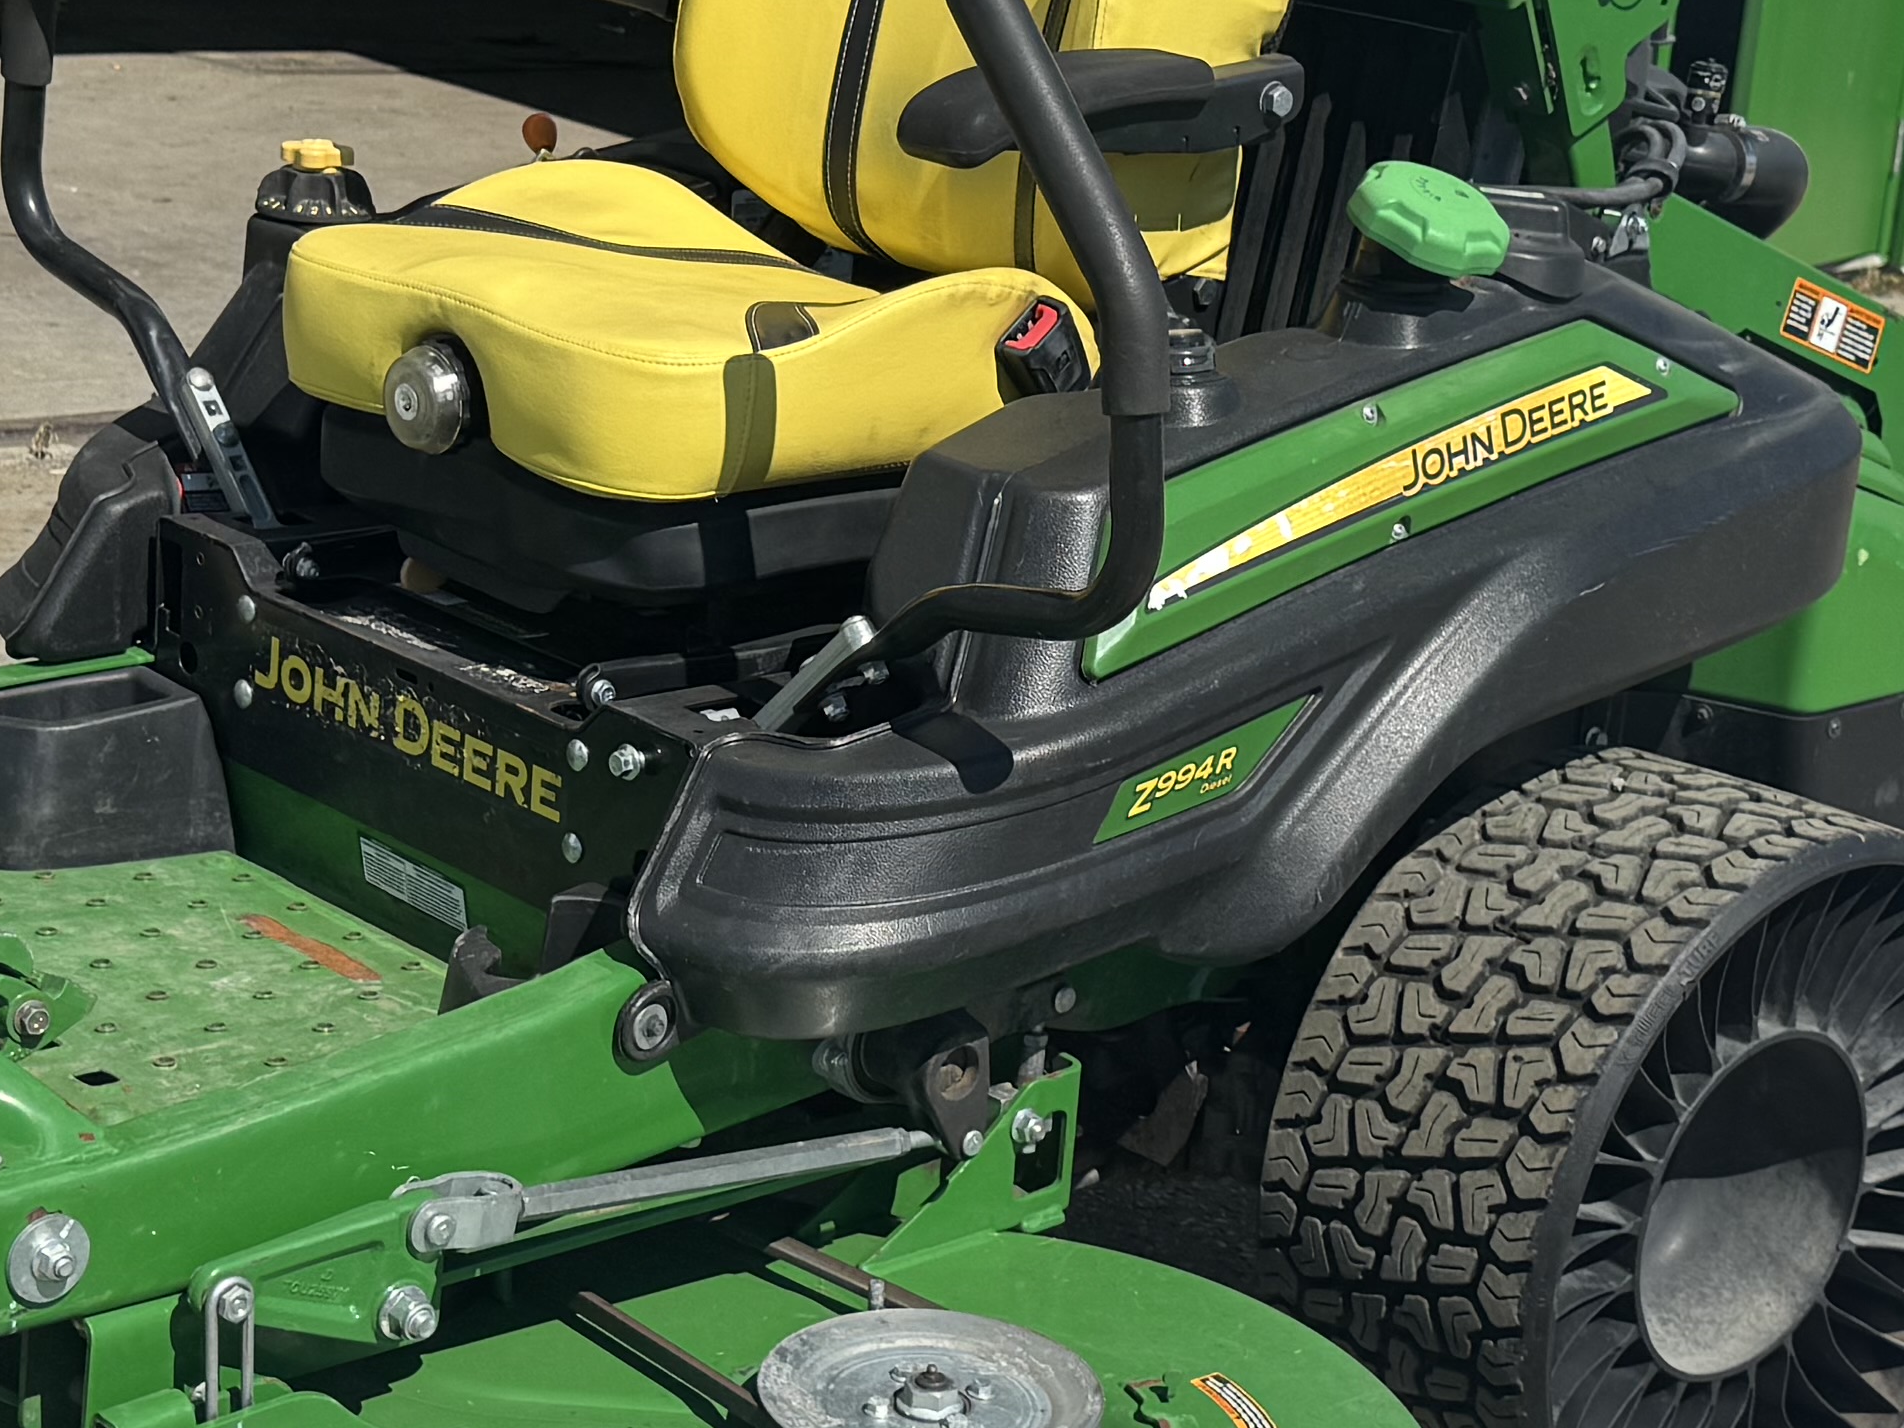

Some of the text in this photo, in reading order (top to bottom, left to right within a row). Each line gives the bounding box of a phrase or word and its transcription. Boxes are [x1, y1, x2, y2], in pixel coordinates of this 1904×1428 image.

[1403, 380, 1609, 492] JOHN DEERE
[255, 636, 562, 823] JOHN DEERE
[1127, 746, 1238, 818] Z994R
